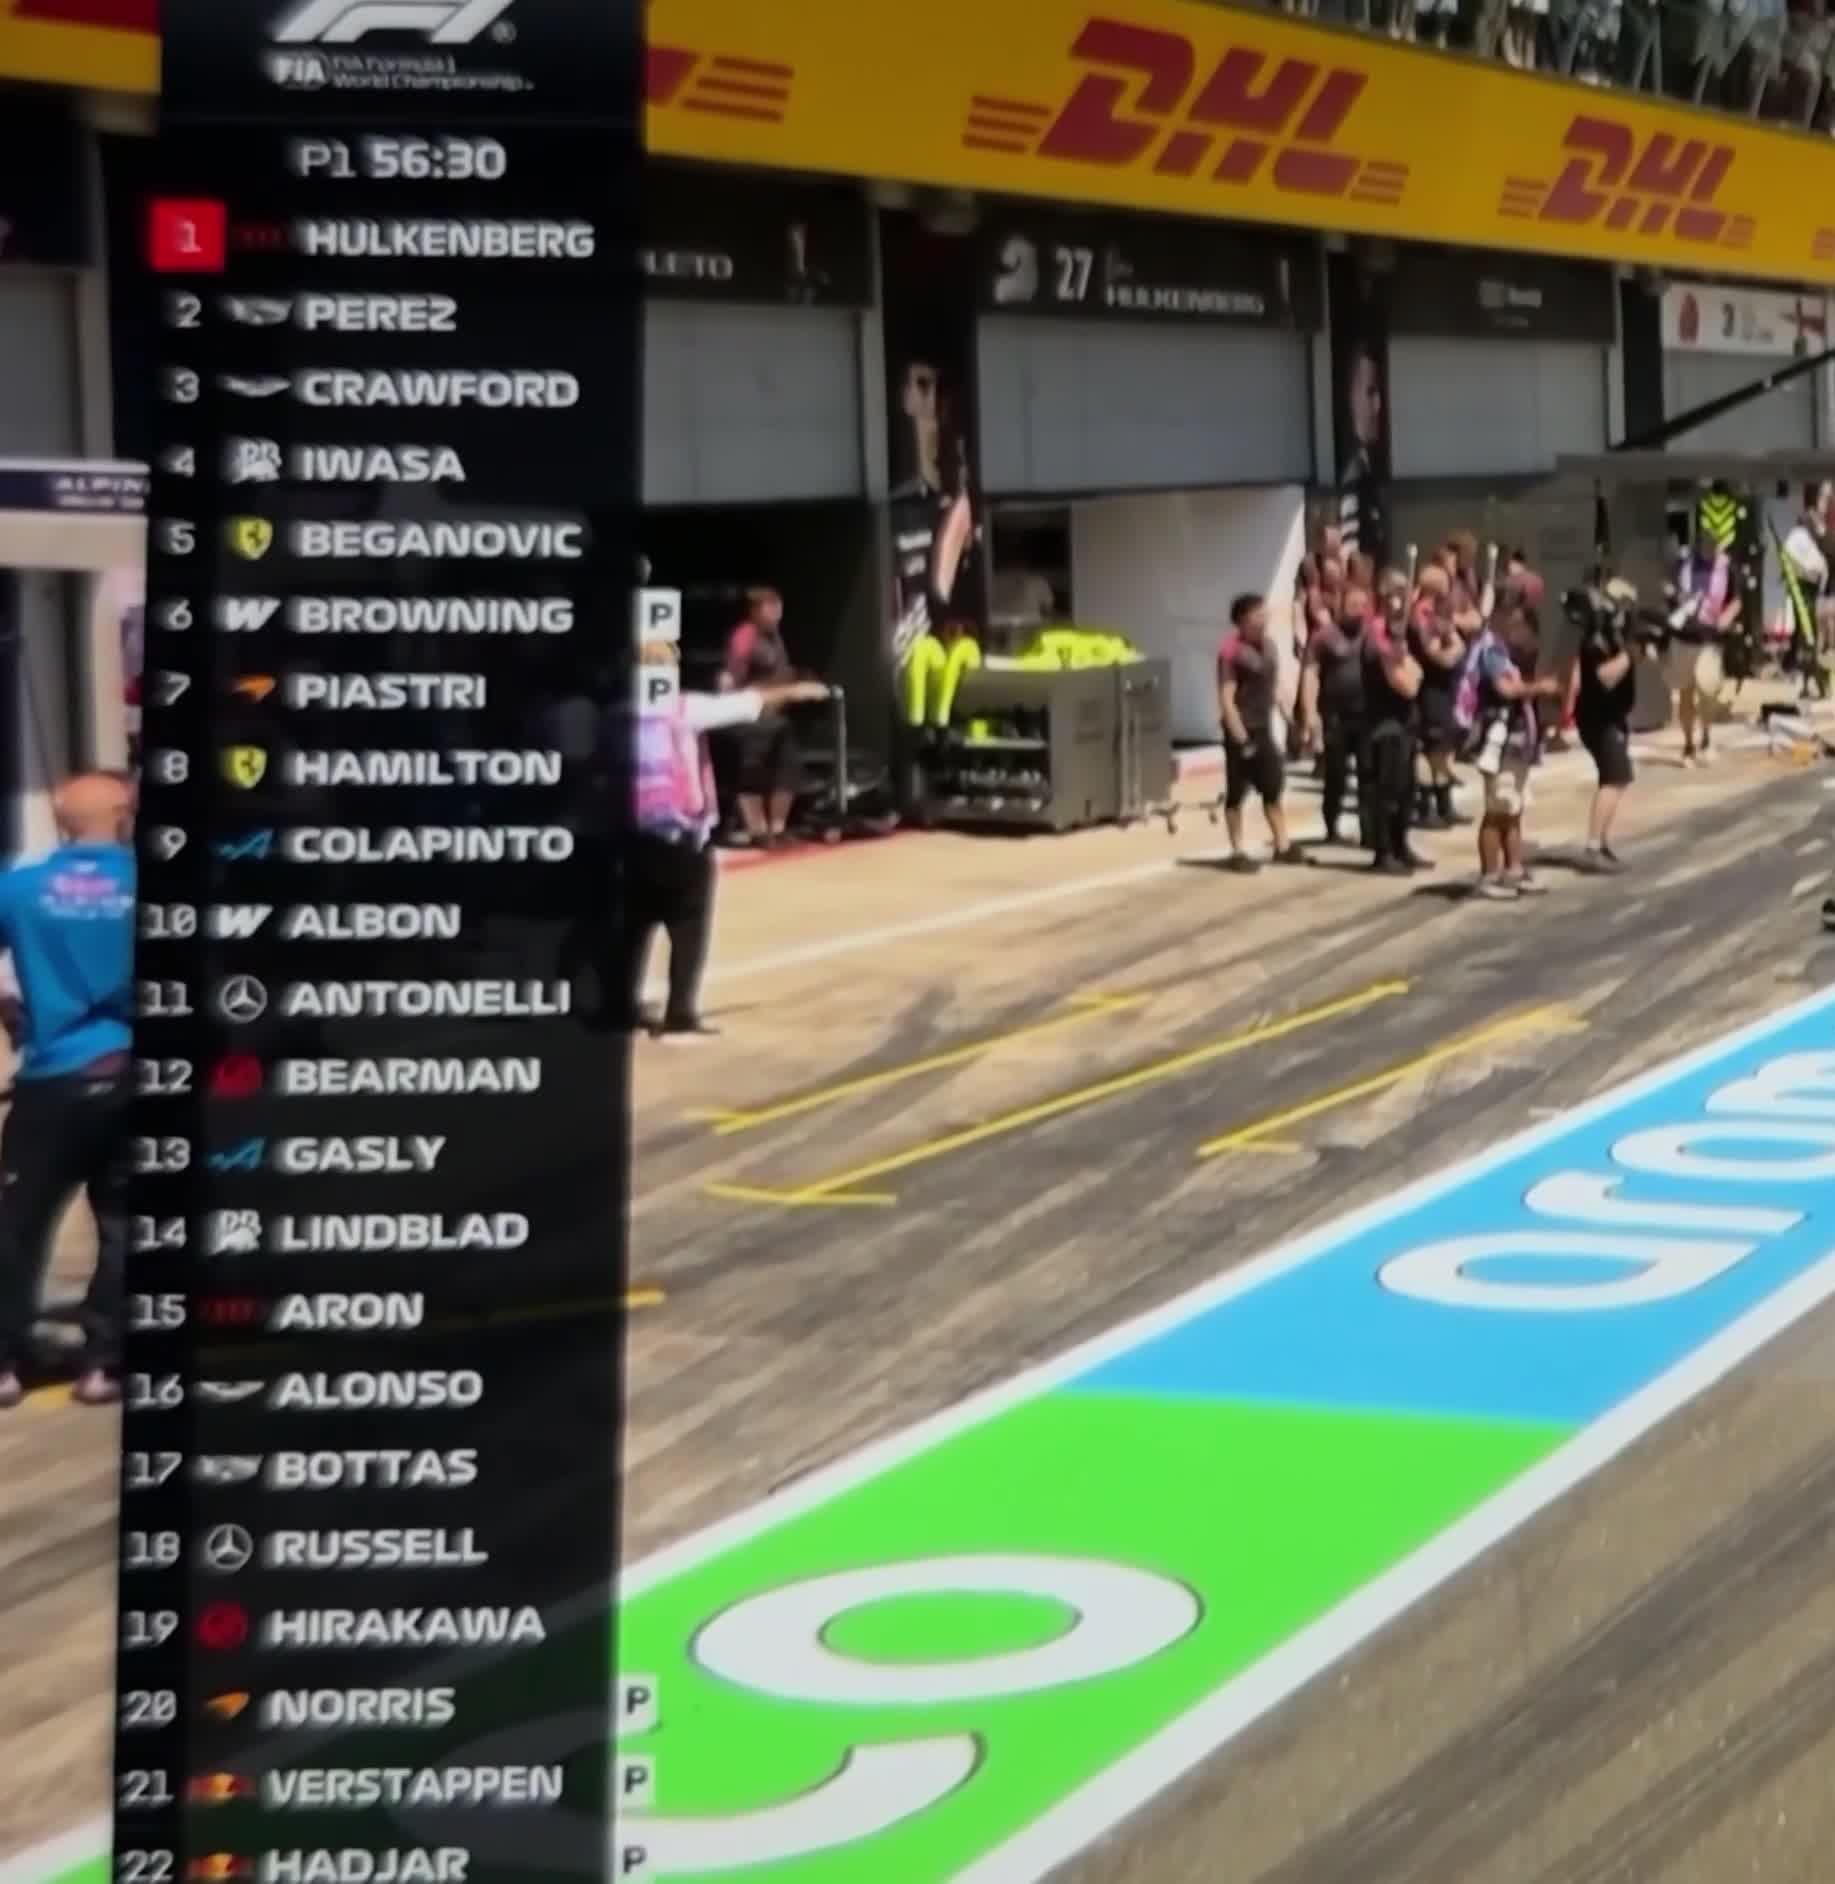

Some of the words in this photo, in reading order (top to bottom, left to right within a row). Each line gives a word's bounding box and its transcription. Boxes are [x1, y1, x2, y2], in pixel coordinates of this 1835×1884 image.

[1036, 17, 1369, 196] DHL
[1539, 115, 1735, 241] DHL
[1055, 247, 1093, 301] 27
